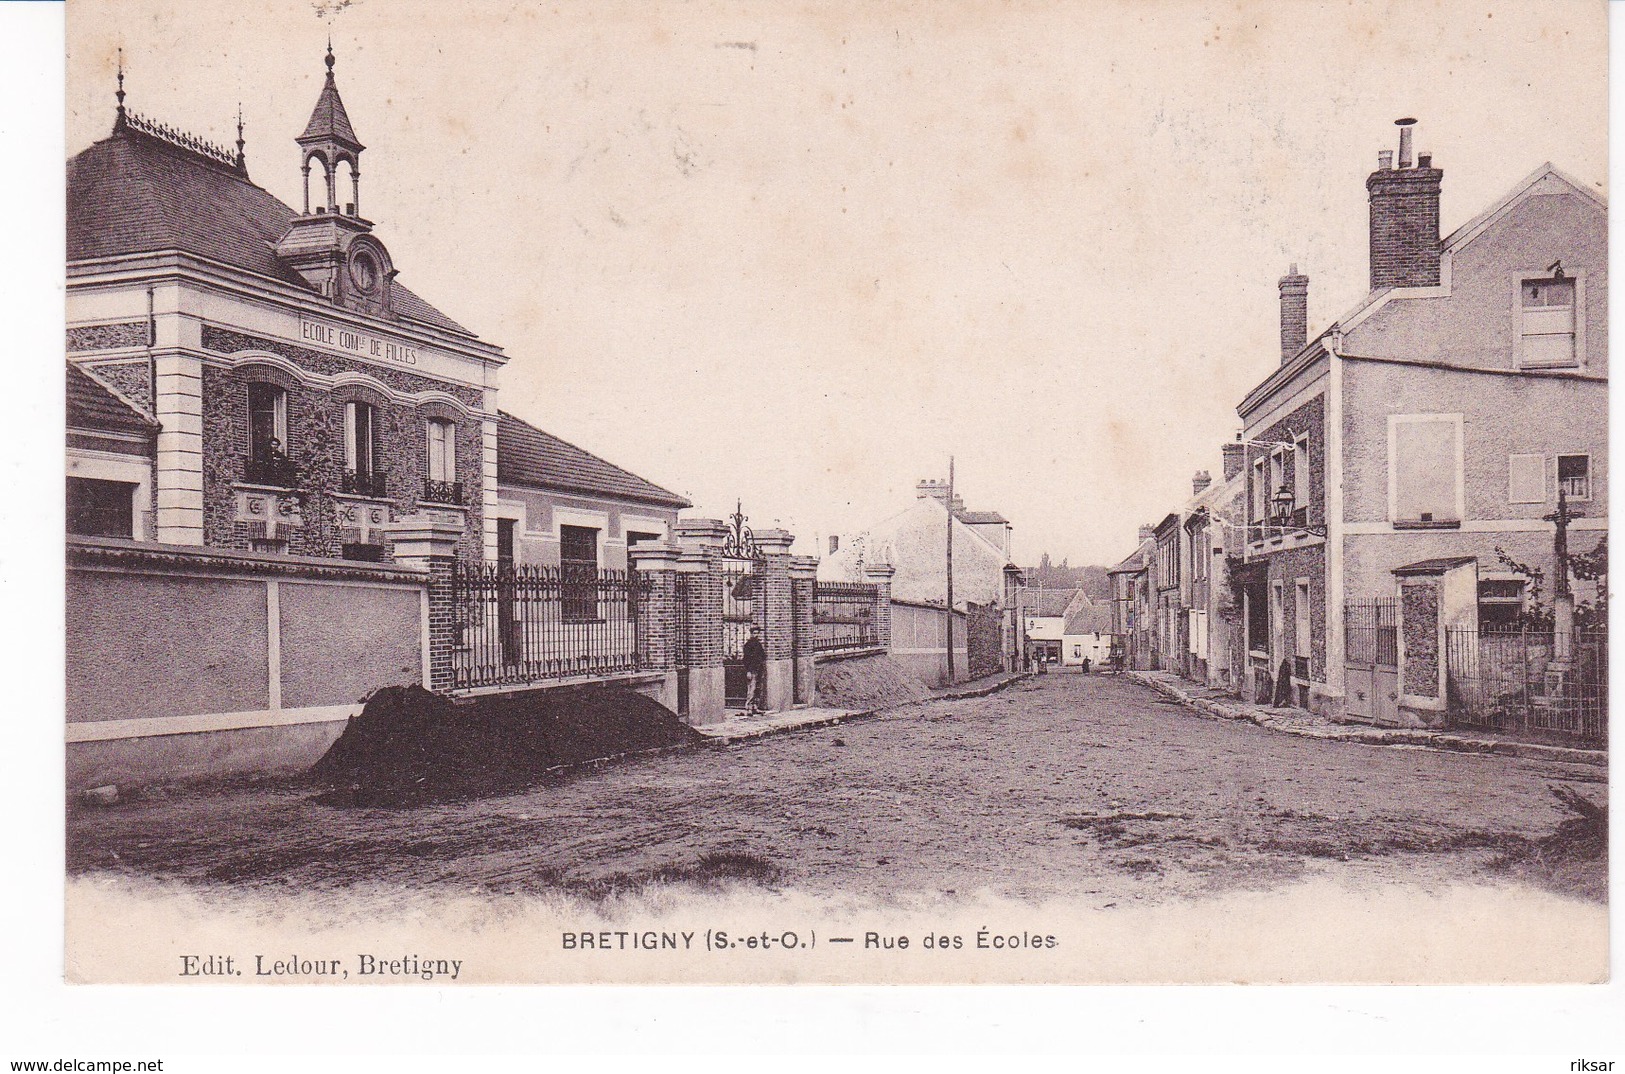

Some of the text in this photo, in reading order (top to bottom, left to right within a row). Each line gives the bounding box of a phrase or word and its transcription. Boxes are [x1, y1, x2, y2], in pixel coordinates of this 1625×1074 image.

[302, 321, 335, 345] ECOLE
[370, 339, 381, 356] DE
[386, 343, 417, 365] FILLES
